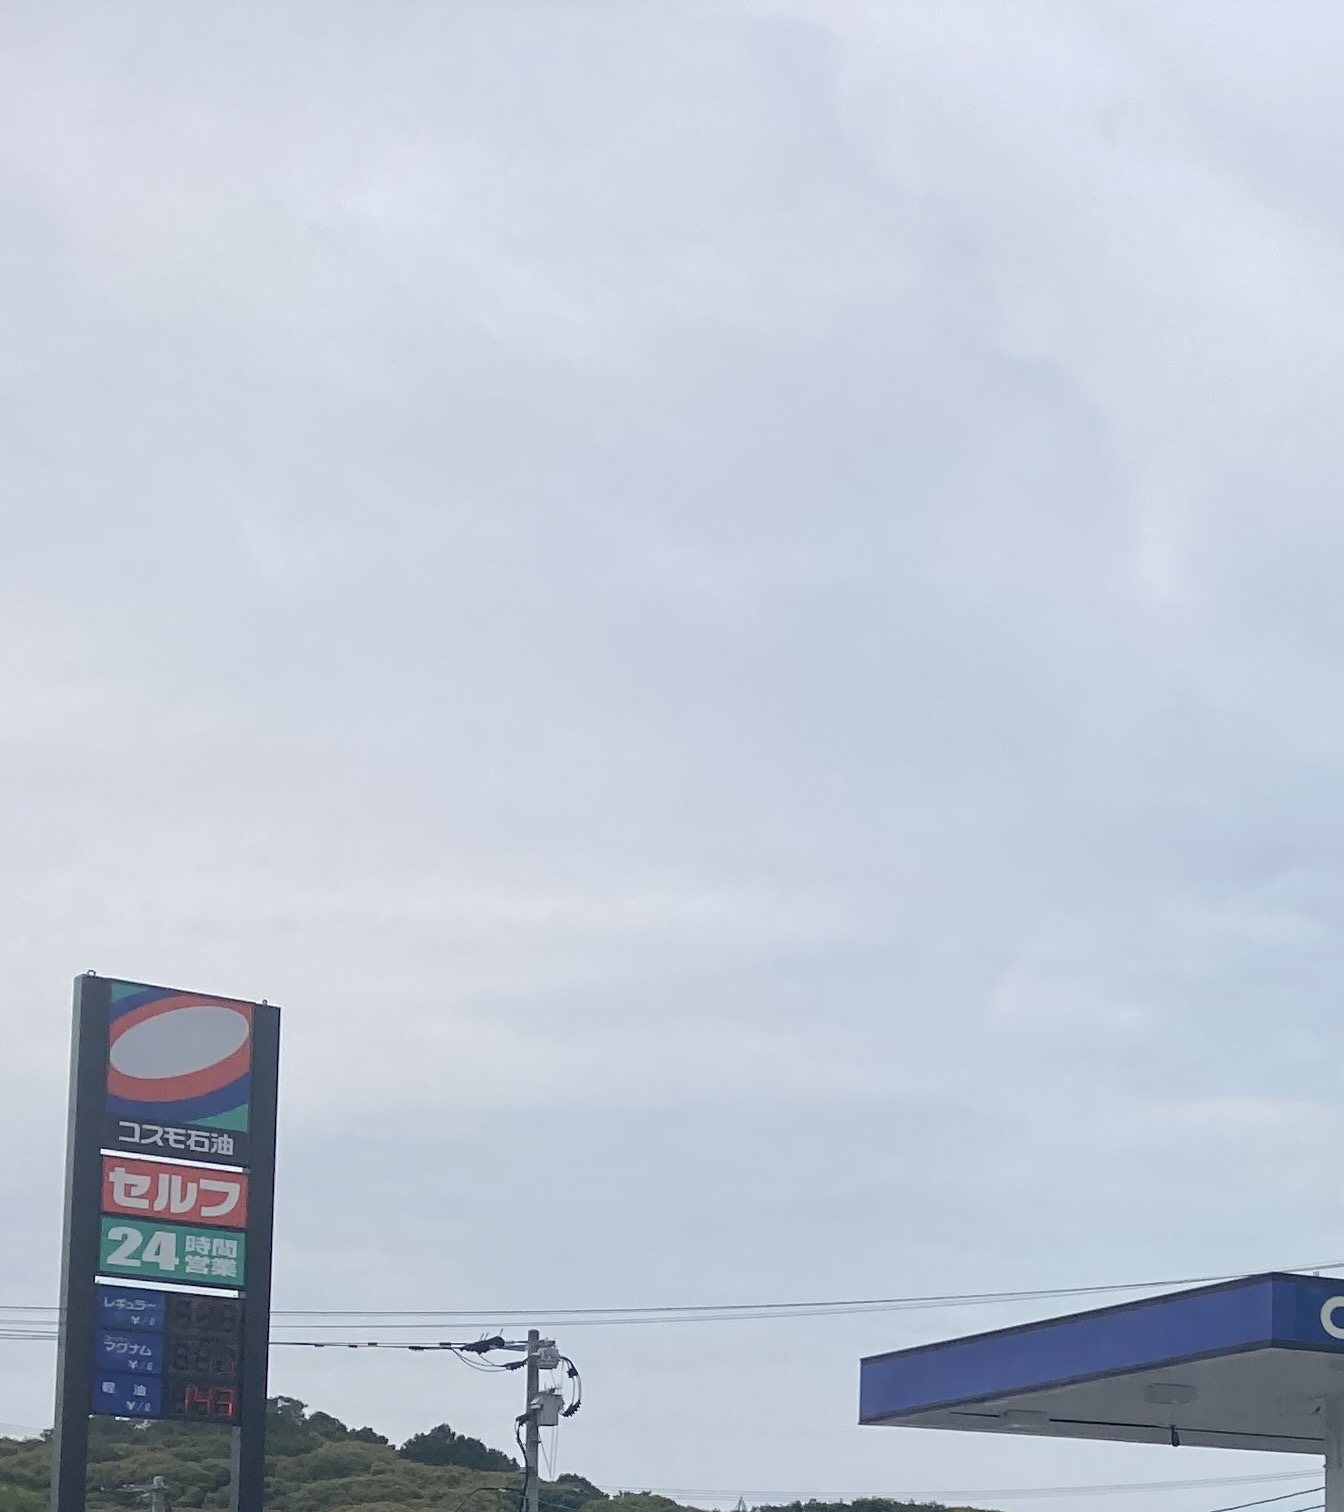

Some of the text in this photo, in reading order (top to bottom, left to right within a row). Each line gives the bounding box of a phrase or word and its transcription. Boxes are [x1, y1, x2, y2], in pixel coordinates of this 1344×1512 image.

[118, 1121, 234, 1155] コスモ石油
[109, 1167, 240, 1217] セルフ
[106, 1226, 238, 1271] 24 時間
[185, 1255, 237, 1277] 営業
[104, 1297, 156, 1311] レギュラー
[104, 1341, 152, 1356] マグナム
[182, 1386, 236, 1417] 143
